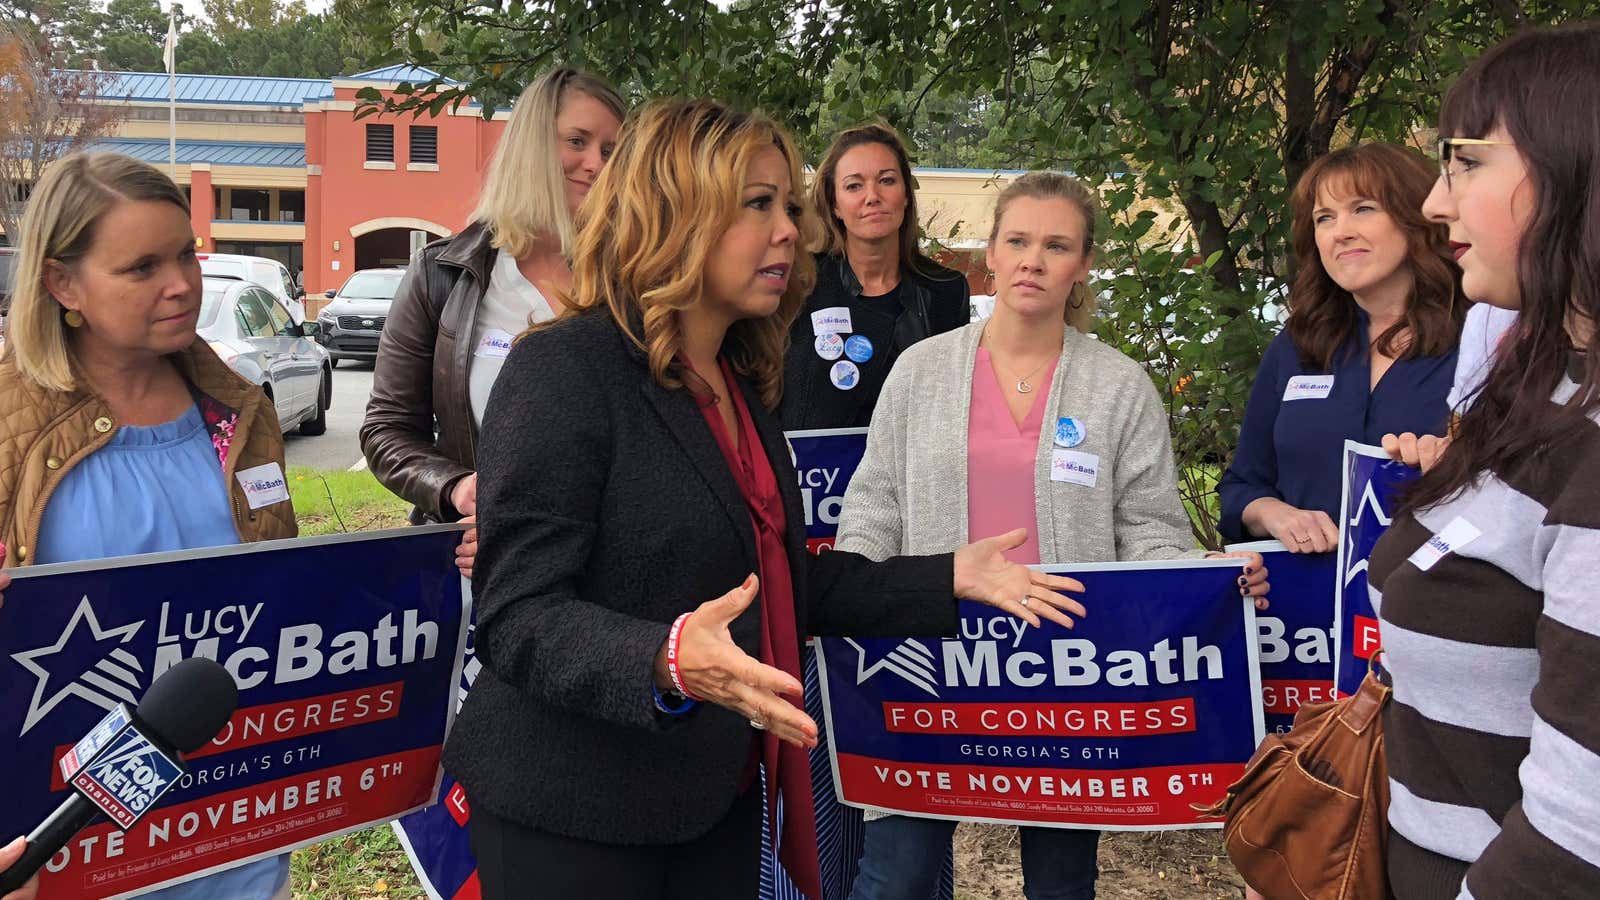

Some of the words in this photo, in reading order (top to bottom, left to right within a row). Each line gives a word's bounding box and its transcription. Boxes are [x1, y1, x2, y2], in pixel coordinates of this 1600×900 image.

[491, 340, 511, 349] McB
[255, 479, 283, 491] McBath
[797, 467, 840, 494] cy
[1066, 463, 1095, 475] McBath
[158, 601, 264, 643] Lucy
[941, 616, 1028, 648] ucy
[941, 636, 1224, 687] McBath
[211, 689, 395, 746] ONGRESS
[891, 708, 959, 730] FOR
[981, 706, 1188, 731] CONGRESS
[168, 755, 272, 793] ORGIA'S
[283, 744, 321, 765] 6TH
[960, 744, 1070, 759] GEORGIA'S
[1082, 746, 1120, 760] 6TH
[95, 761, 149, 811] NEWS
[120, 755, 167, 797] FOX
[874, 765, 952, 791] VOTE
[968, 773, 1150, 799] NOVEMBER
[1168, 773, 1214, 796] 6TH
[45, 830, 125, 873] OTE
[148, 775, 343, 847] NOVEMBER
[360, 761, 403, 791] 6TH
[78, 777, 132, 823] channel
